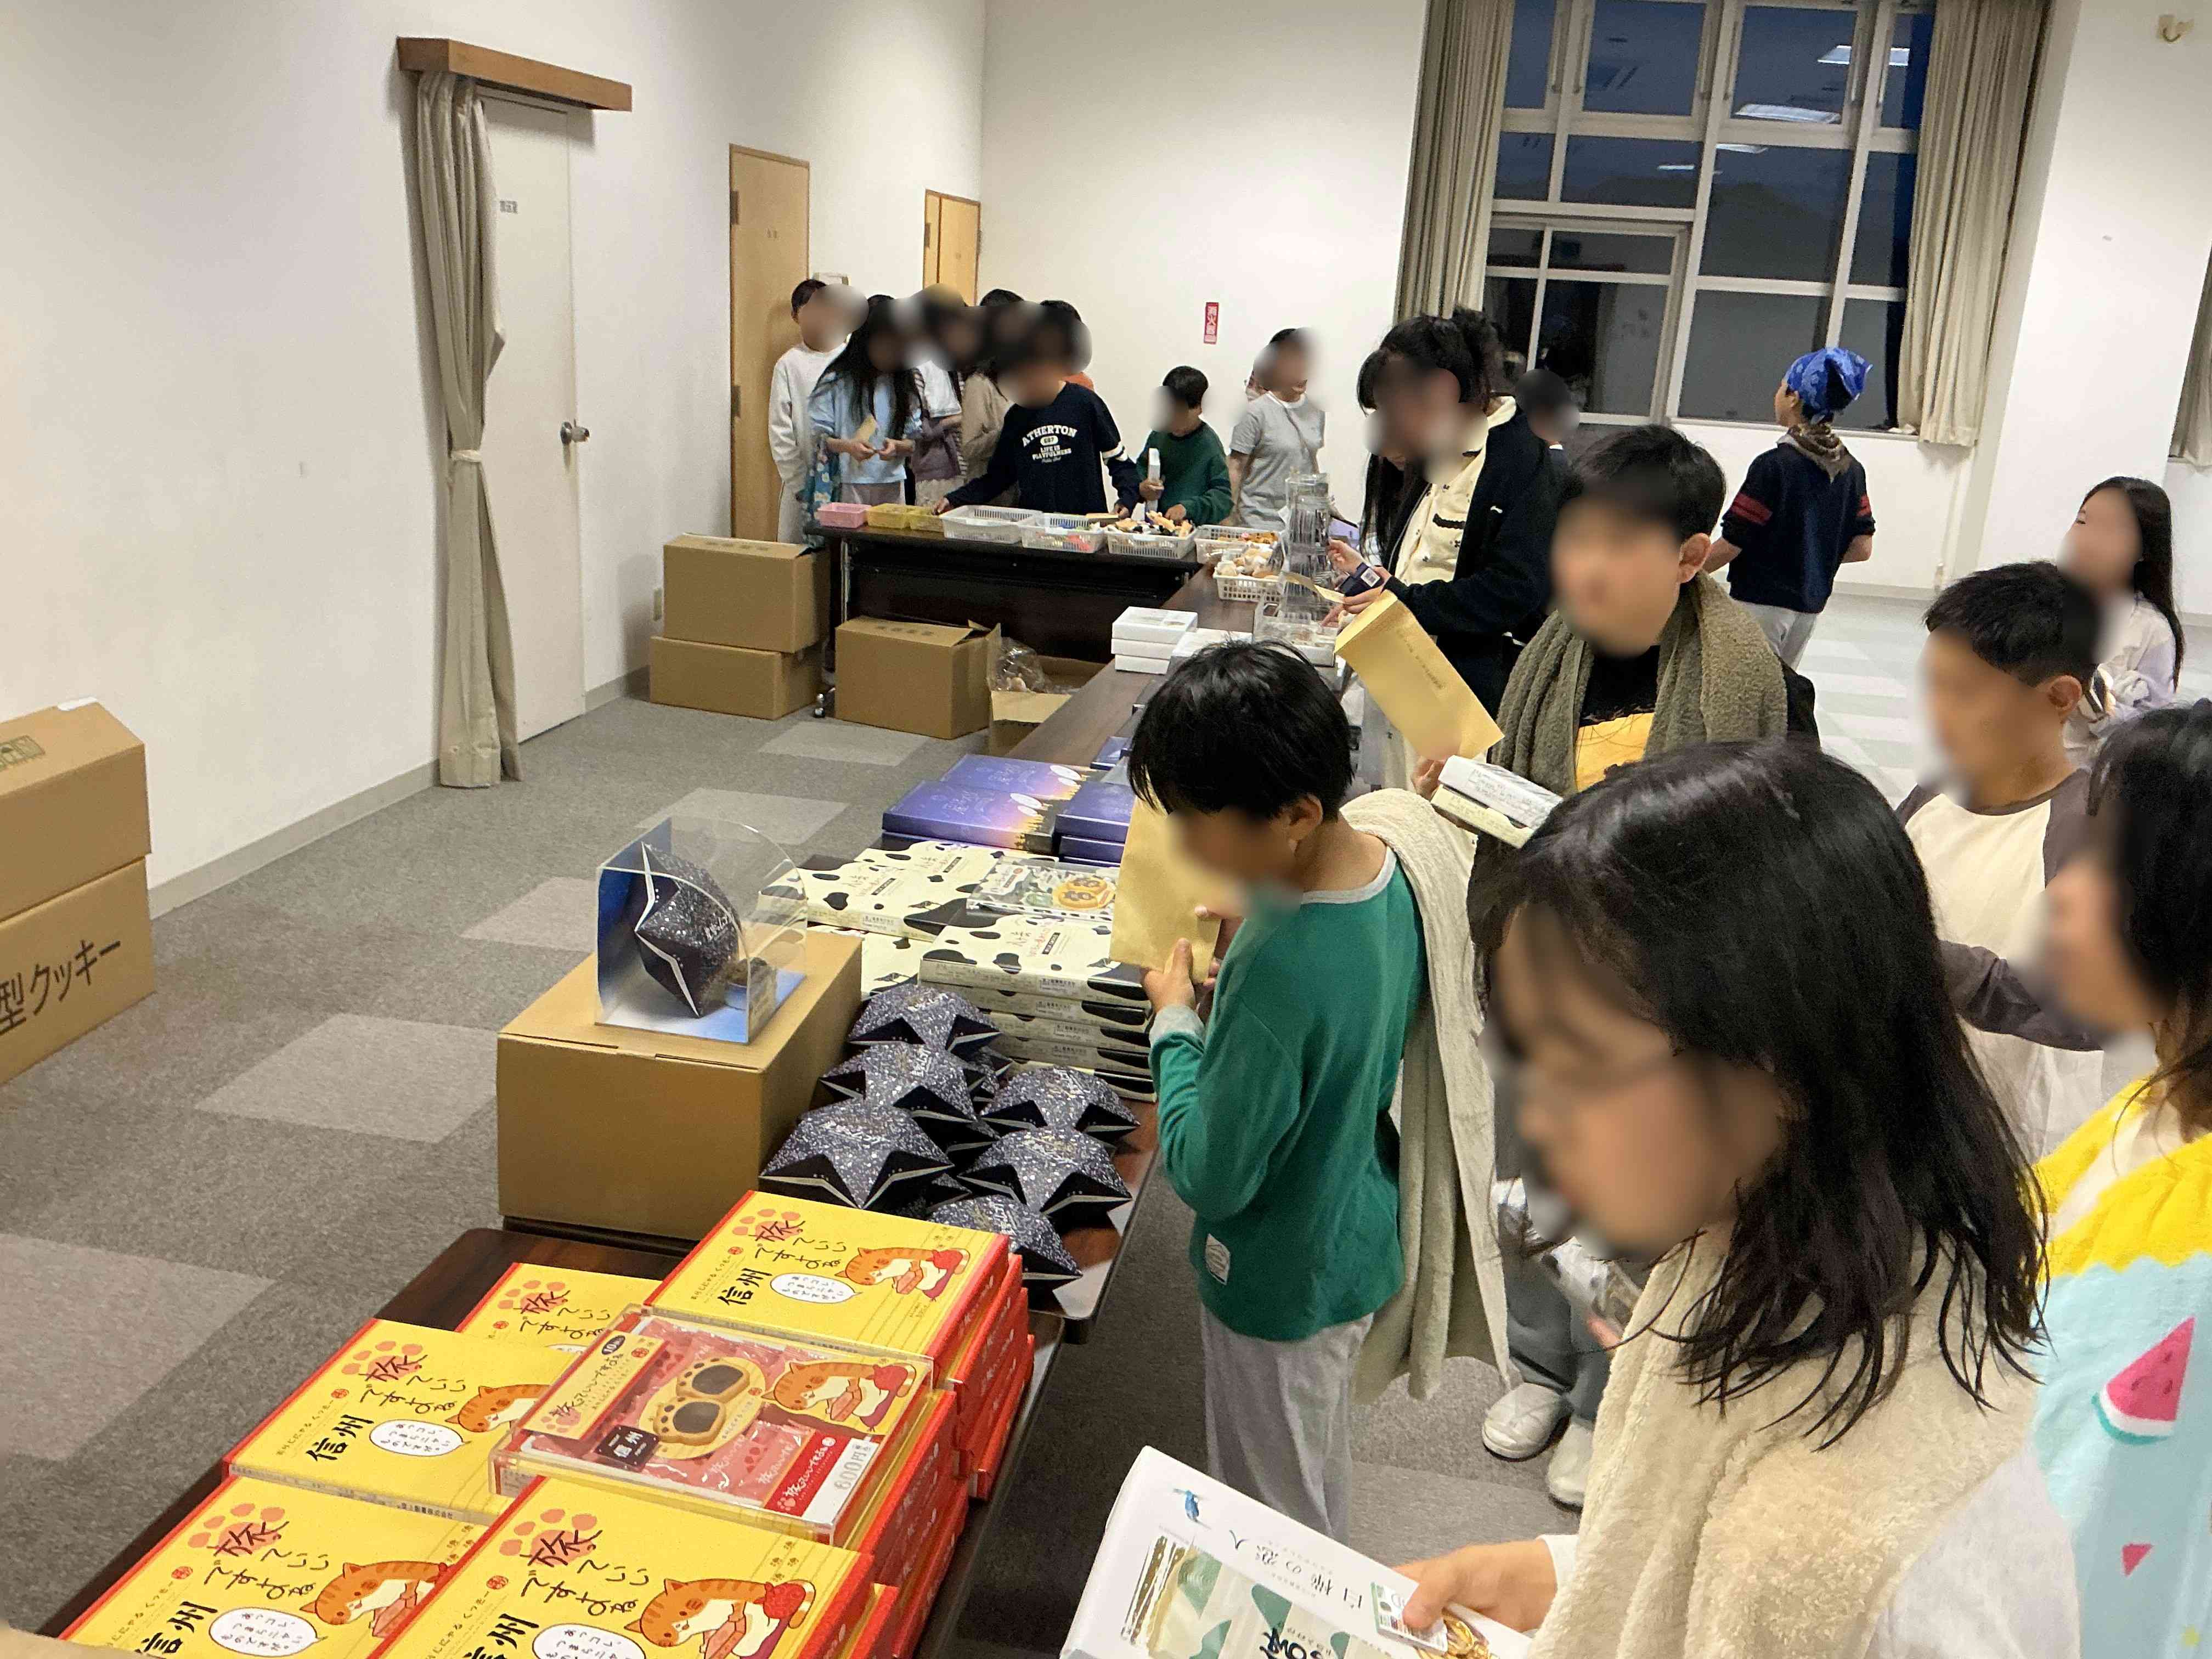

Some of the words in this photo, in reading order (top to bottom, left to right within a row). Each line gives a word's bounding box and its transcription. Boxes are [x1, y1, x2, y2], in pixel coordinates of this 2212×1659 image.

[1022, 425, 1077, 447] ATHERTON
[1032, 448, 1071, 460] PLAYFULNESS
[0, 939, 121, 1034] 型クッキー
[717, 1268, 772, 1306] 信州
[306, 1414, 375, 1462] 信州
[614, 1430, 646, 1458] 信州
[833, 1452, 867, 1489] 600円
[1229, 1530, 1363, 1610] 白樺の恋人
[135, 1601, 219, 1658] 信州
